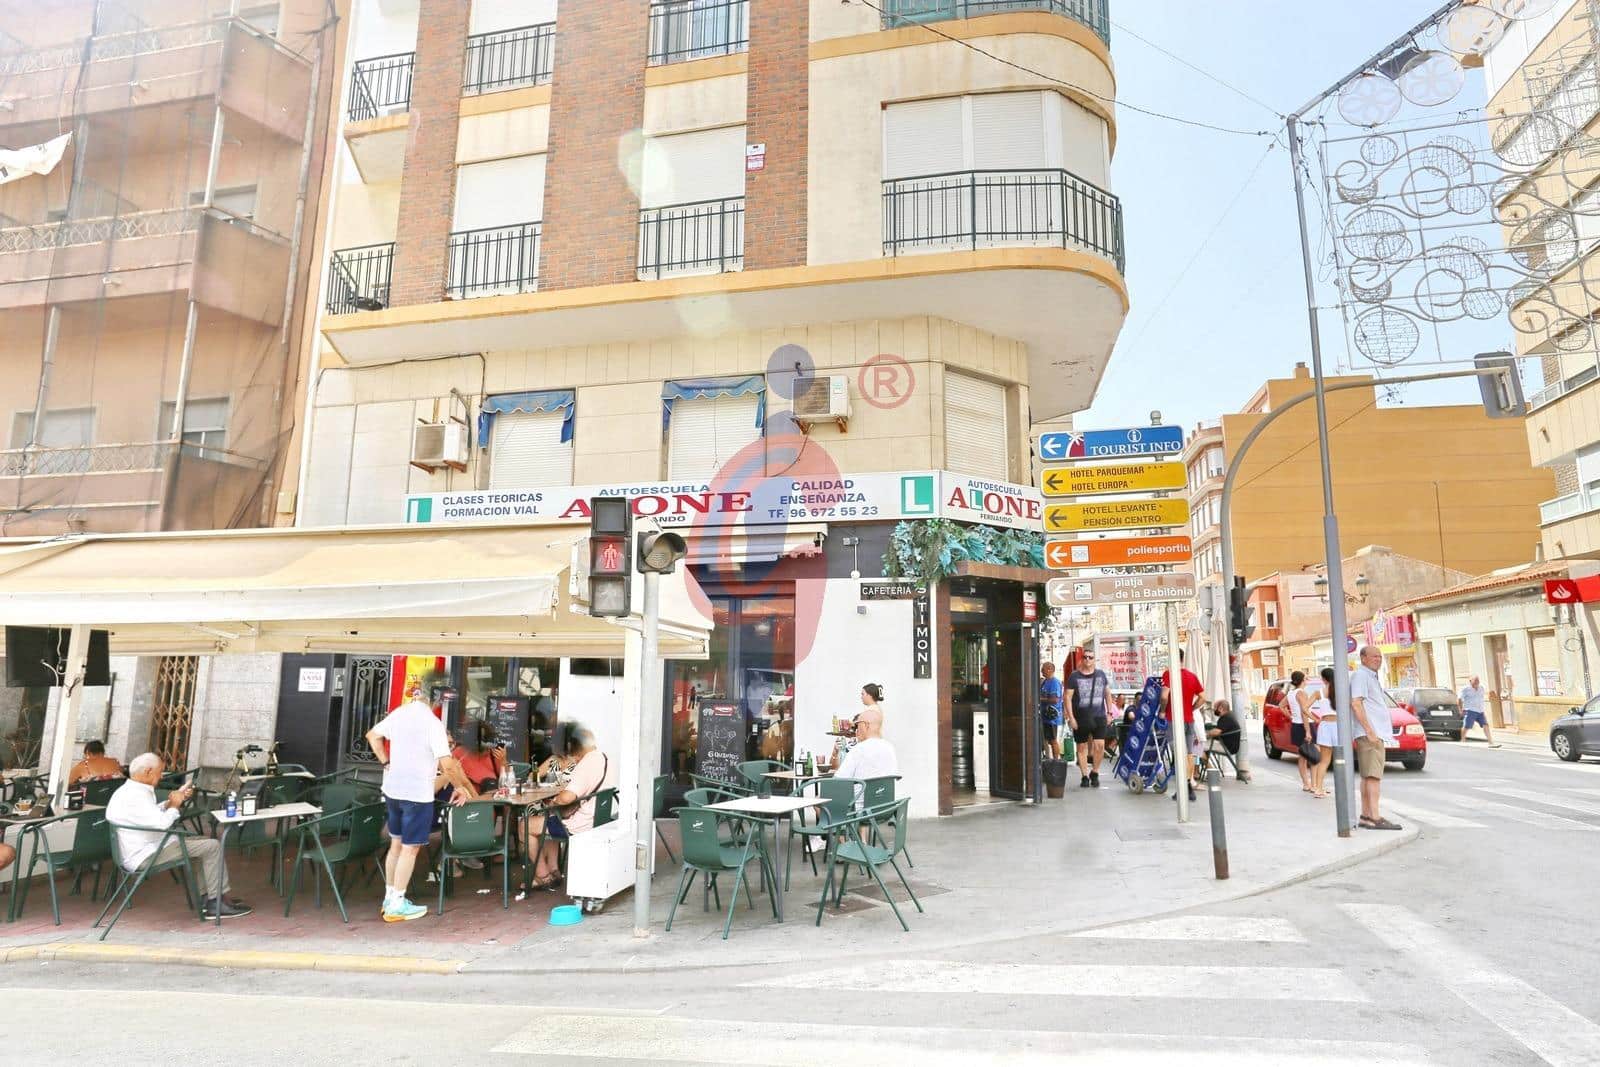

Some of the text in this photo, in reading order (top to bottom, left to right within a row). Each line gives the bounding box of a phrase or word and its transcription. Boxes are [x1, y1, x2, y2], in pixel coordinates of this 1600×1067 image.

[1090, 440, 1181, 456] TOURIST INFO
[1070, 466, 1144, 478] HOTEL PARQUEMAR
[599, 484, 711, 496] AUTOESCUELA
[791, 479, 854, 491] CALIDAD
[966, 480, 1022, 496] AUTOESCUELA
[1071, 480, 1128, 491] HOTEL EUROPA
[442, 493, 543, 505] CLASES TEORICAS
[780, 491, 866, 505] ENSEÑANZA
[947, 487, 1041, 520] ALONE
[558, 491, 753, 518] AONE
[1082, 503, 1157, 514] HOTEL LEVANTE
[444, 505, 540, 517] FORMACION VIAL
[790, 508, 807, 518] 96
[810, 507, 836, 517] 672
[840, 507, 857, 516] 55
[861, 506, 878, 515] 23
[1083, 515, 1162, 526] PENSION CENTRO
[1127, 544, 1191, 557] poliesportiu
[1114, 577, 1144, 588] platja
[862, 586, 912, 595] CAFETERIA
[1115, 587, 1193, 599] de la Babilònia
